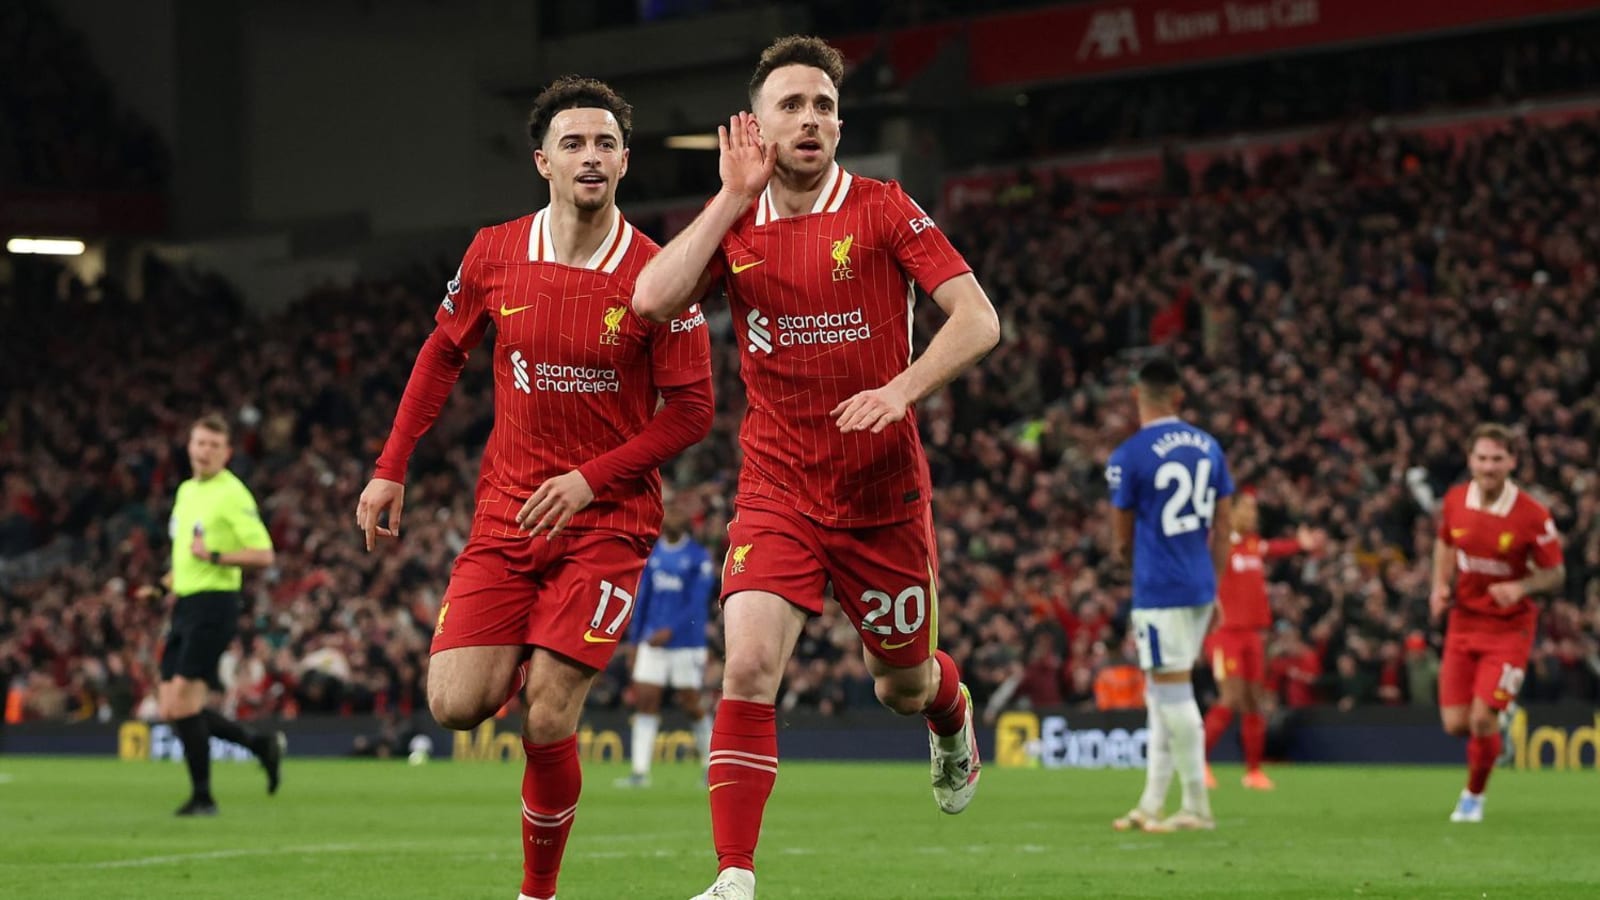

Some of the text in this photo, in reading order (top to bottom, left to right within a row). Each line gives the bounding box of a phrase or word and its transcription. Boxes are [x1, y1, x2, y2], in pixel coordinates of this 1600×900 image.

[777, 308, 862, 330] standard
[779, 323, 870, 346] chartered
[536, 362, 615, 380] standard
[536, 378, 619, 394] chartered
[1154, 458, 1216, 537] 24
[591, 580, 632, 635] 17
[861, 586, 925, 635] 20
